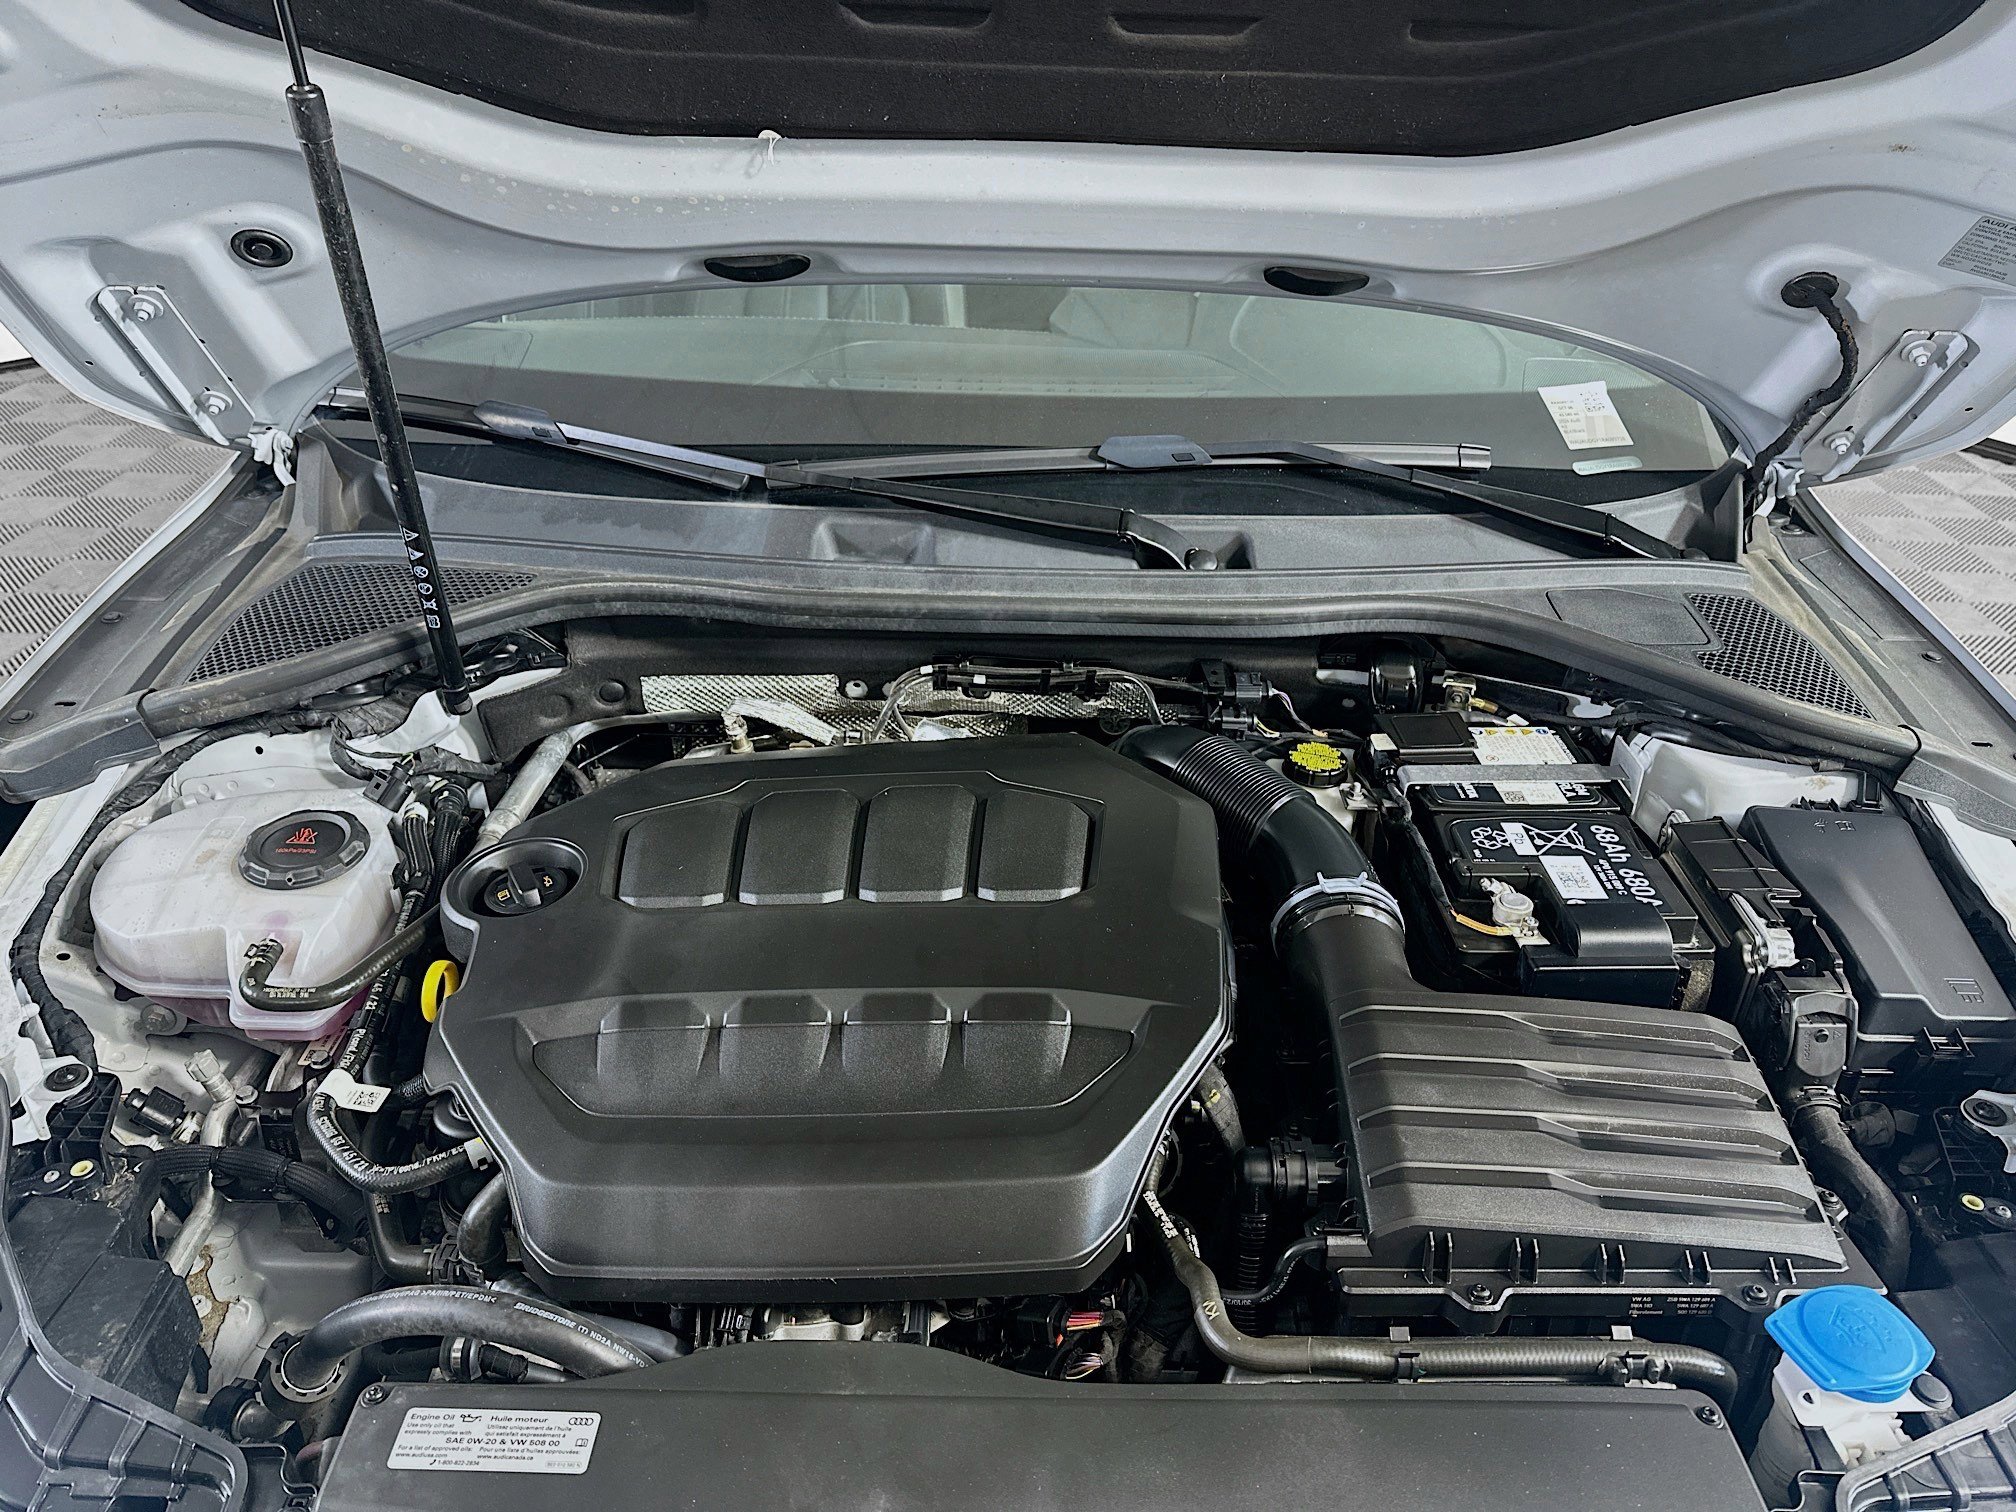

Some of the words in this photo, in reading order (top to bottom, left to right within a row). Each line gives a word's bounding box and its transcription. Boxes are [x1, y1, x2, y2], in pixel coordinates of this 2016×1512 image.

[1982, 218, 2009, 229] AUDI
[1511, 832, 1524, 845] Pb
[1590, 824, 1631, 863] 68Ah
[513, 1302, 577, 1328] BRIDGESTONE
[577, 1325, 589, 1335] (T)
[589, 1331, 612, 1347] ND2A
[411, 1413, 440, 1421] Engine
[443, 1413, 456, 1421] Oil
[466, 1437, 497, 1445] 0W-20
[529, 1439, 547, 1447] 508
